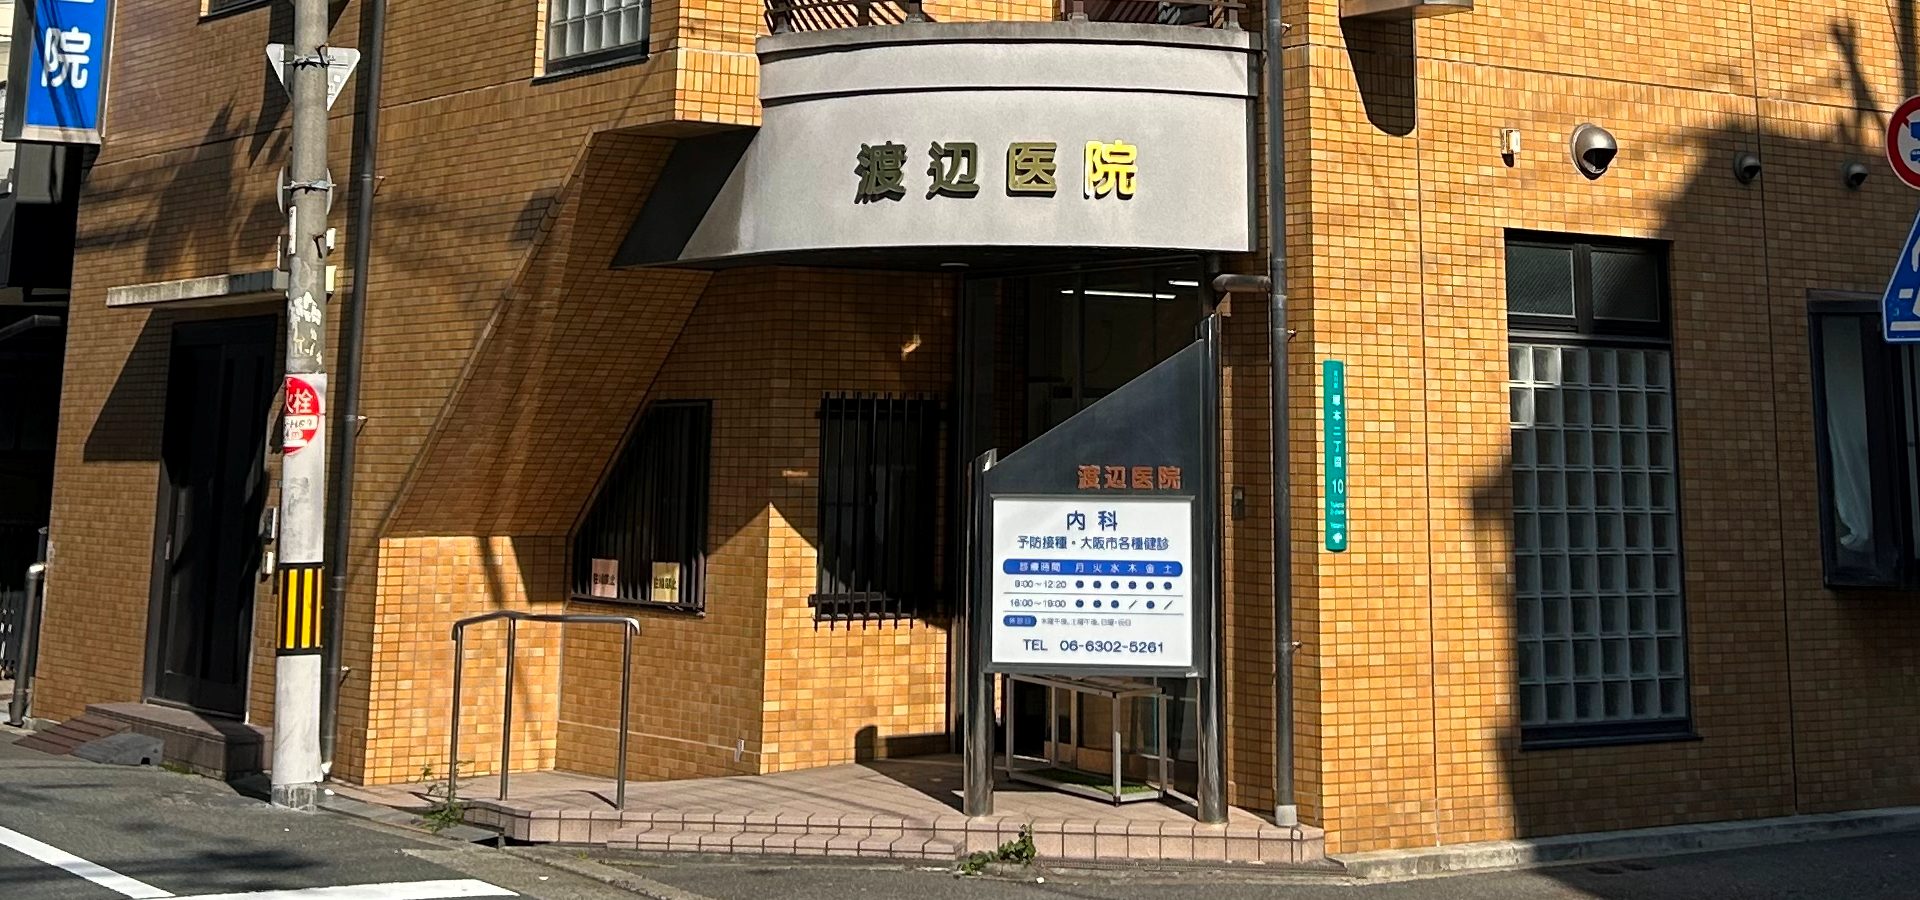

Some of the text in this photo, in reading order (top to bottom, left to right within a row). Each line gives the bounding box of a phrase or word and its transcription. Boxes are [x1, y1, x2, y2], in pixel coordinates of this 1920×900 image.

[41, 0, 94, 89] 院
[854, 140, 1138, 204] 渡辺医院
[1077, 464, 1183, 490] 渡辺医院
[1332, 478, 1344, 495] 10
[1066, 510, 1118, 531] 内科
[1075, 563, 1085, 573] 月
[1092, 563, 1103, 574] 火
[1127, 563, 1138, 574] 木
[1163, 564, 1173, 575] 土
[1023, 638, 1164, 654] TEL 06-6302-5261
